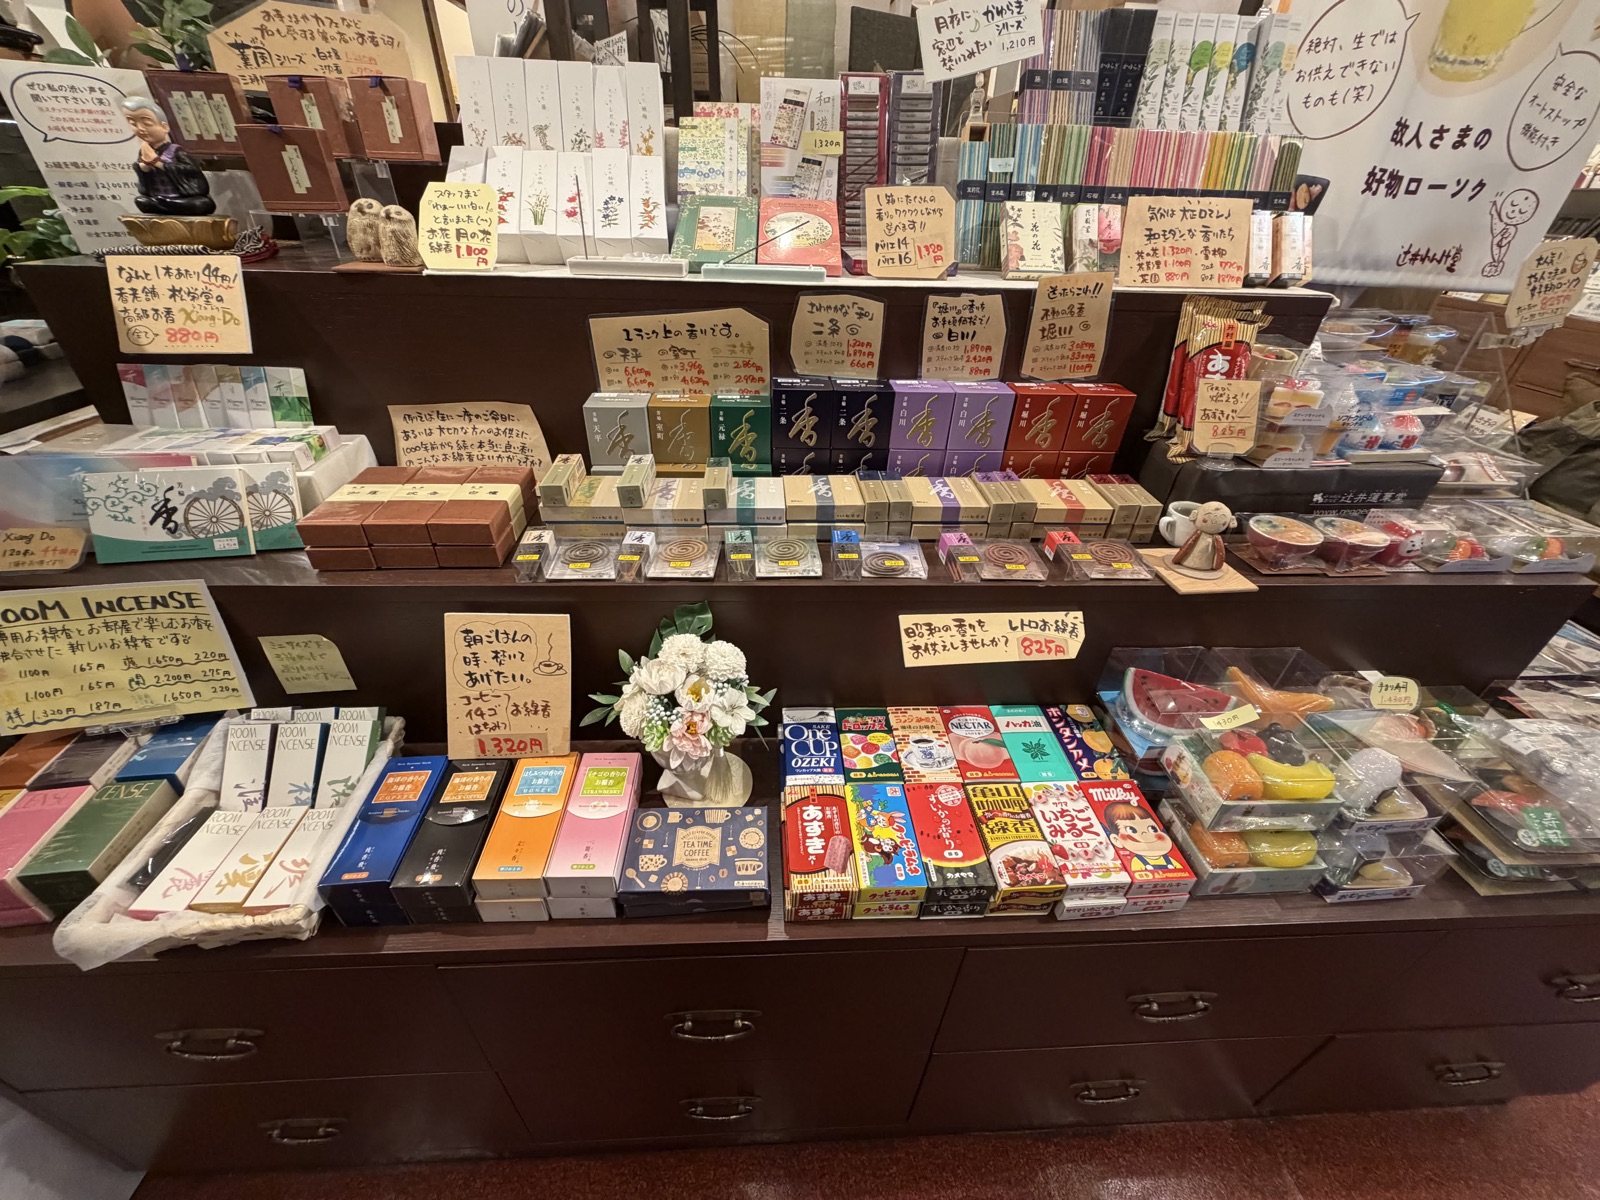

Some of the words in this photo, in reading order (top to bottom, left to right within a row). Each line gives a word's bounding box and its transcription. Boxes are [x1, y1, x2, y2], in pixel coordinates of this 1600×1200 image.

[935, 8, 971, 34] 月夜に
[995, 17, 1027, 36] シリーズ
[1305, 30, 1398, 54] 絶対、生では
[1295, 61, 1397, 82] お供えできない
[26, 82, 106, 95] ぜひ私の渋い声を
[1551, 74, 1589, 101] 安全な
[1302, 84, 1375, 109] ものも(笑)
[1390, 117, 1493, 150] 故人さまの
[1519, 122, 1560, 152] 機能付き
[1361, 165, 1488, 200] 好物ローソク
[426, 227, 450, 240] お花
[1030, 222, 1041, 251] 花の花
[165, 327, 219, 343] 880円
[812, 318, 841, 338] 二条
[948, 328, 977, 342] 白川
[1038, 323, 1073, 340] 堀川
[850, 360, 874, 369] 660円
[969, 366, 990, 376] 880円
[779, 407, 788, 426] 二条
[787, 392, 818, 447] 香
[838, 408, 847, 427] 二条
[847, 392, 878, 447] 香
[898, 409, 908, 427] 白川
[906, 394, 938, 448] 香
[958, 410, 967, 427] 白川
[964, 395, 998, 447] 香
[1018, 410, 1029, 428] 堀川
[1076, 411, 1087, 428] 堀川
[1200, 408, 1251, 421] あずきバー
[593, 424, 602, 442] 天平
[656, 423, 665, 441] 室町
[718, 424, 726, 442] 元禄
[727, 408, 758, 461] 香
[40, 532, 56, 540] Do
[0, 600, 70, 626] OOM
[81, 591, 206, 618] INCENSE
[903, 618, 989, 638] 昭和の香りを
[1008, 618, 1080, 639] レトロお線香
[460, 628, 532, 649] 朝ごはんの
[1020, 637, 1066, 656] 825円
[73, 663, 105, 673] 165円
[195, 651, 226, 661] 220円
[80, 681, 115, 691] 165円
[201, 669, 231, 677] 275円
[463, 669, 532, 688] あげたい。
[90, 701, 122, 712] 187円
[510, 700, 552, 718] お線香
[279, 726, 307, 738] ROOM
[331, 722, 359, 733] ROOM
[842, 722, 888, 731] ドロップス
[950, 721, 992, 730] NECTAR
[1004, 719, 1042, 729] ハッカ油
[229, 727, 257, 739] ROOM
[330, 735, 367, 747] INCENSE
[785, 725, 831, 741] One
[229, 740, 266, 752] INCENSE
[277, 738, 316, 751] INCENSE
[791, 757, 836, 768] OZEKI
[530, 777, 550, 786] お線香
[594, 778, 615, 787] お線香
[972, 784, 1021, 798] 亀山
[1089, 787, 1140, 805] Milky
[1052, 800, 1069, 808] サクマ
[211, 811, 242, 823] ROOM
[261, 808, 290, 819] ROOM
[306, 810, 335, 820] ROOM
[1039, 807, 1090, 823] いちご
[254, 818, 296, 829] INCENSE
[802, 805, 827, 855] あずき
[985, 821, 1036, 834] 線香
[1046, 824, 1101, 839] みるく
[683, 840, 695, 848] TEA
[697, 840, 713, 848] TIME
[802, 892, 842, 902] あずき
[797, 908, 836, 917] あずき
